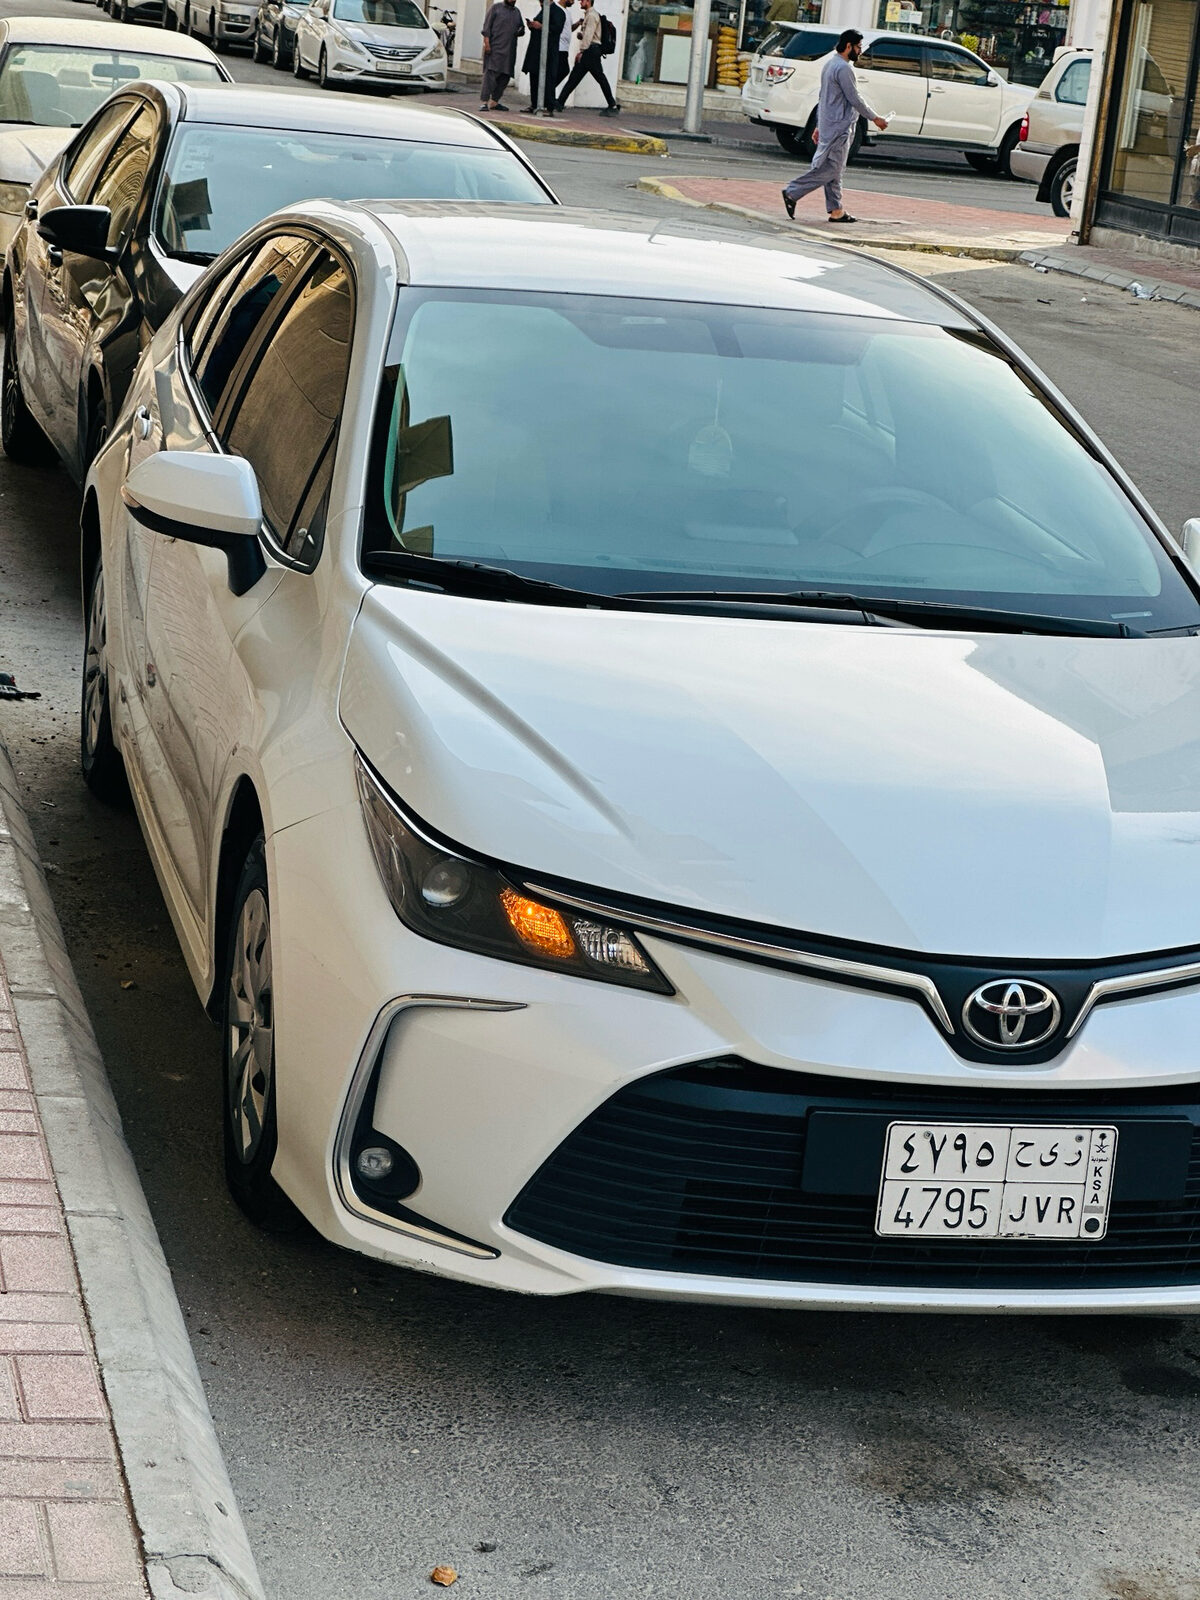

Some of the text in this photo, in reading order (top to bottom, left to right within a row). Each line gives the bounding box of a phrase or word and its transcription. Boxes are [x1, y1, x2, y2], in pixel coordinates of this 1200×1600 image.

[900, 1132, 995, 1174] ٤٧٩٥
[1090, 1166, 1103, 1204] KSA
[893, 1187, 1076, 1229] 4795 JVR
